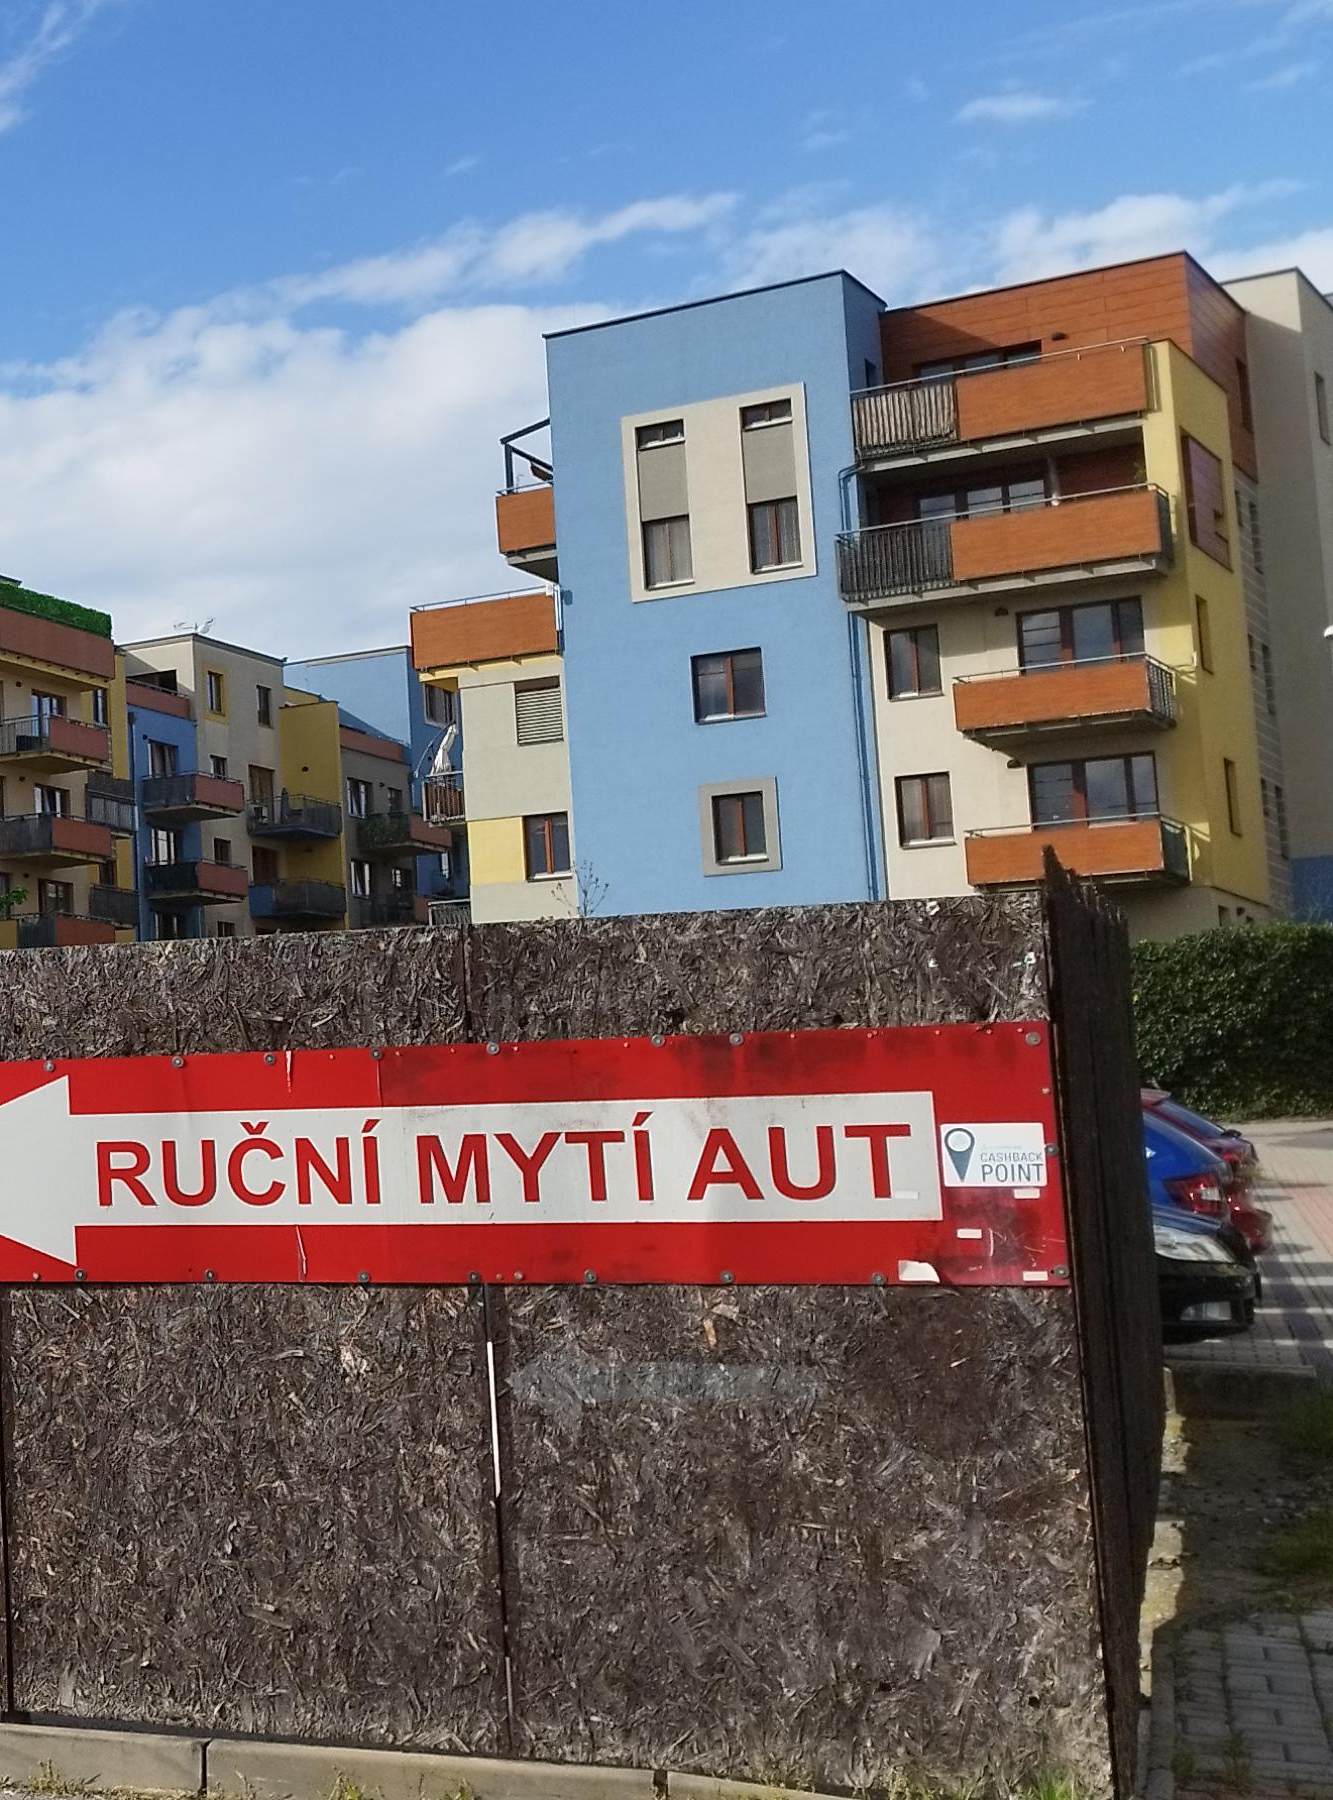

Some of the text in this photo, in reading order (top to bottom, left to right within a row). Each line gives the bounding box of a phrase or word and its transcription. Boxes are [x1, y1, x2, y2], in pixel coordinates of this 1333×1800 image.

[96, 1111, 912, 1207] RUČNÍ MYTÍ AUT
[980, 1151, 1043, 1162] CASHBACK
[981, 1163, 1044, 1183] POINT
